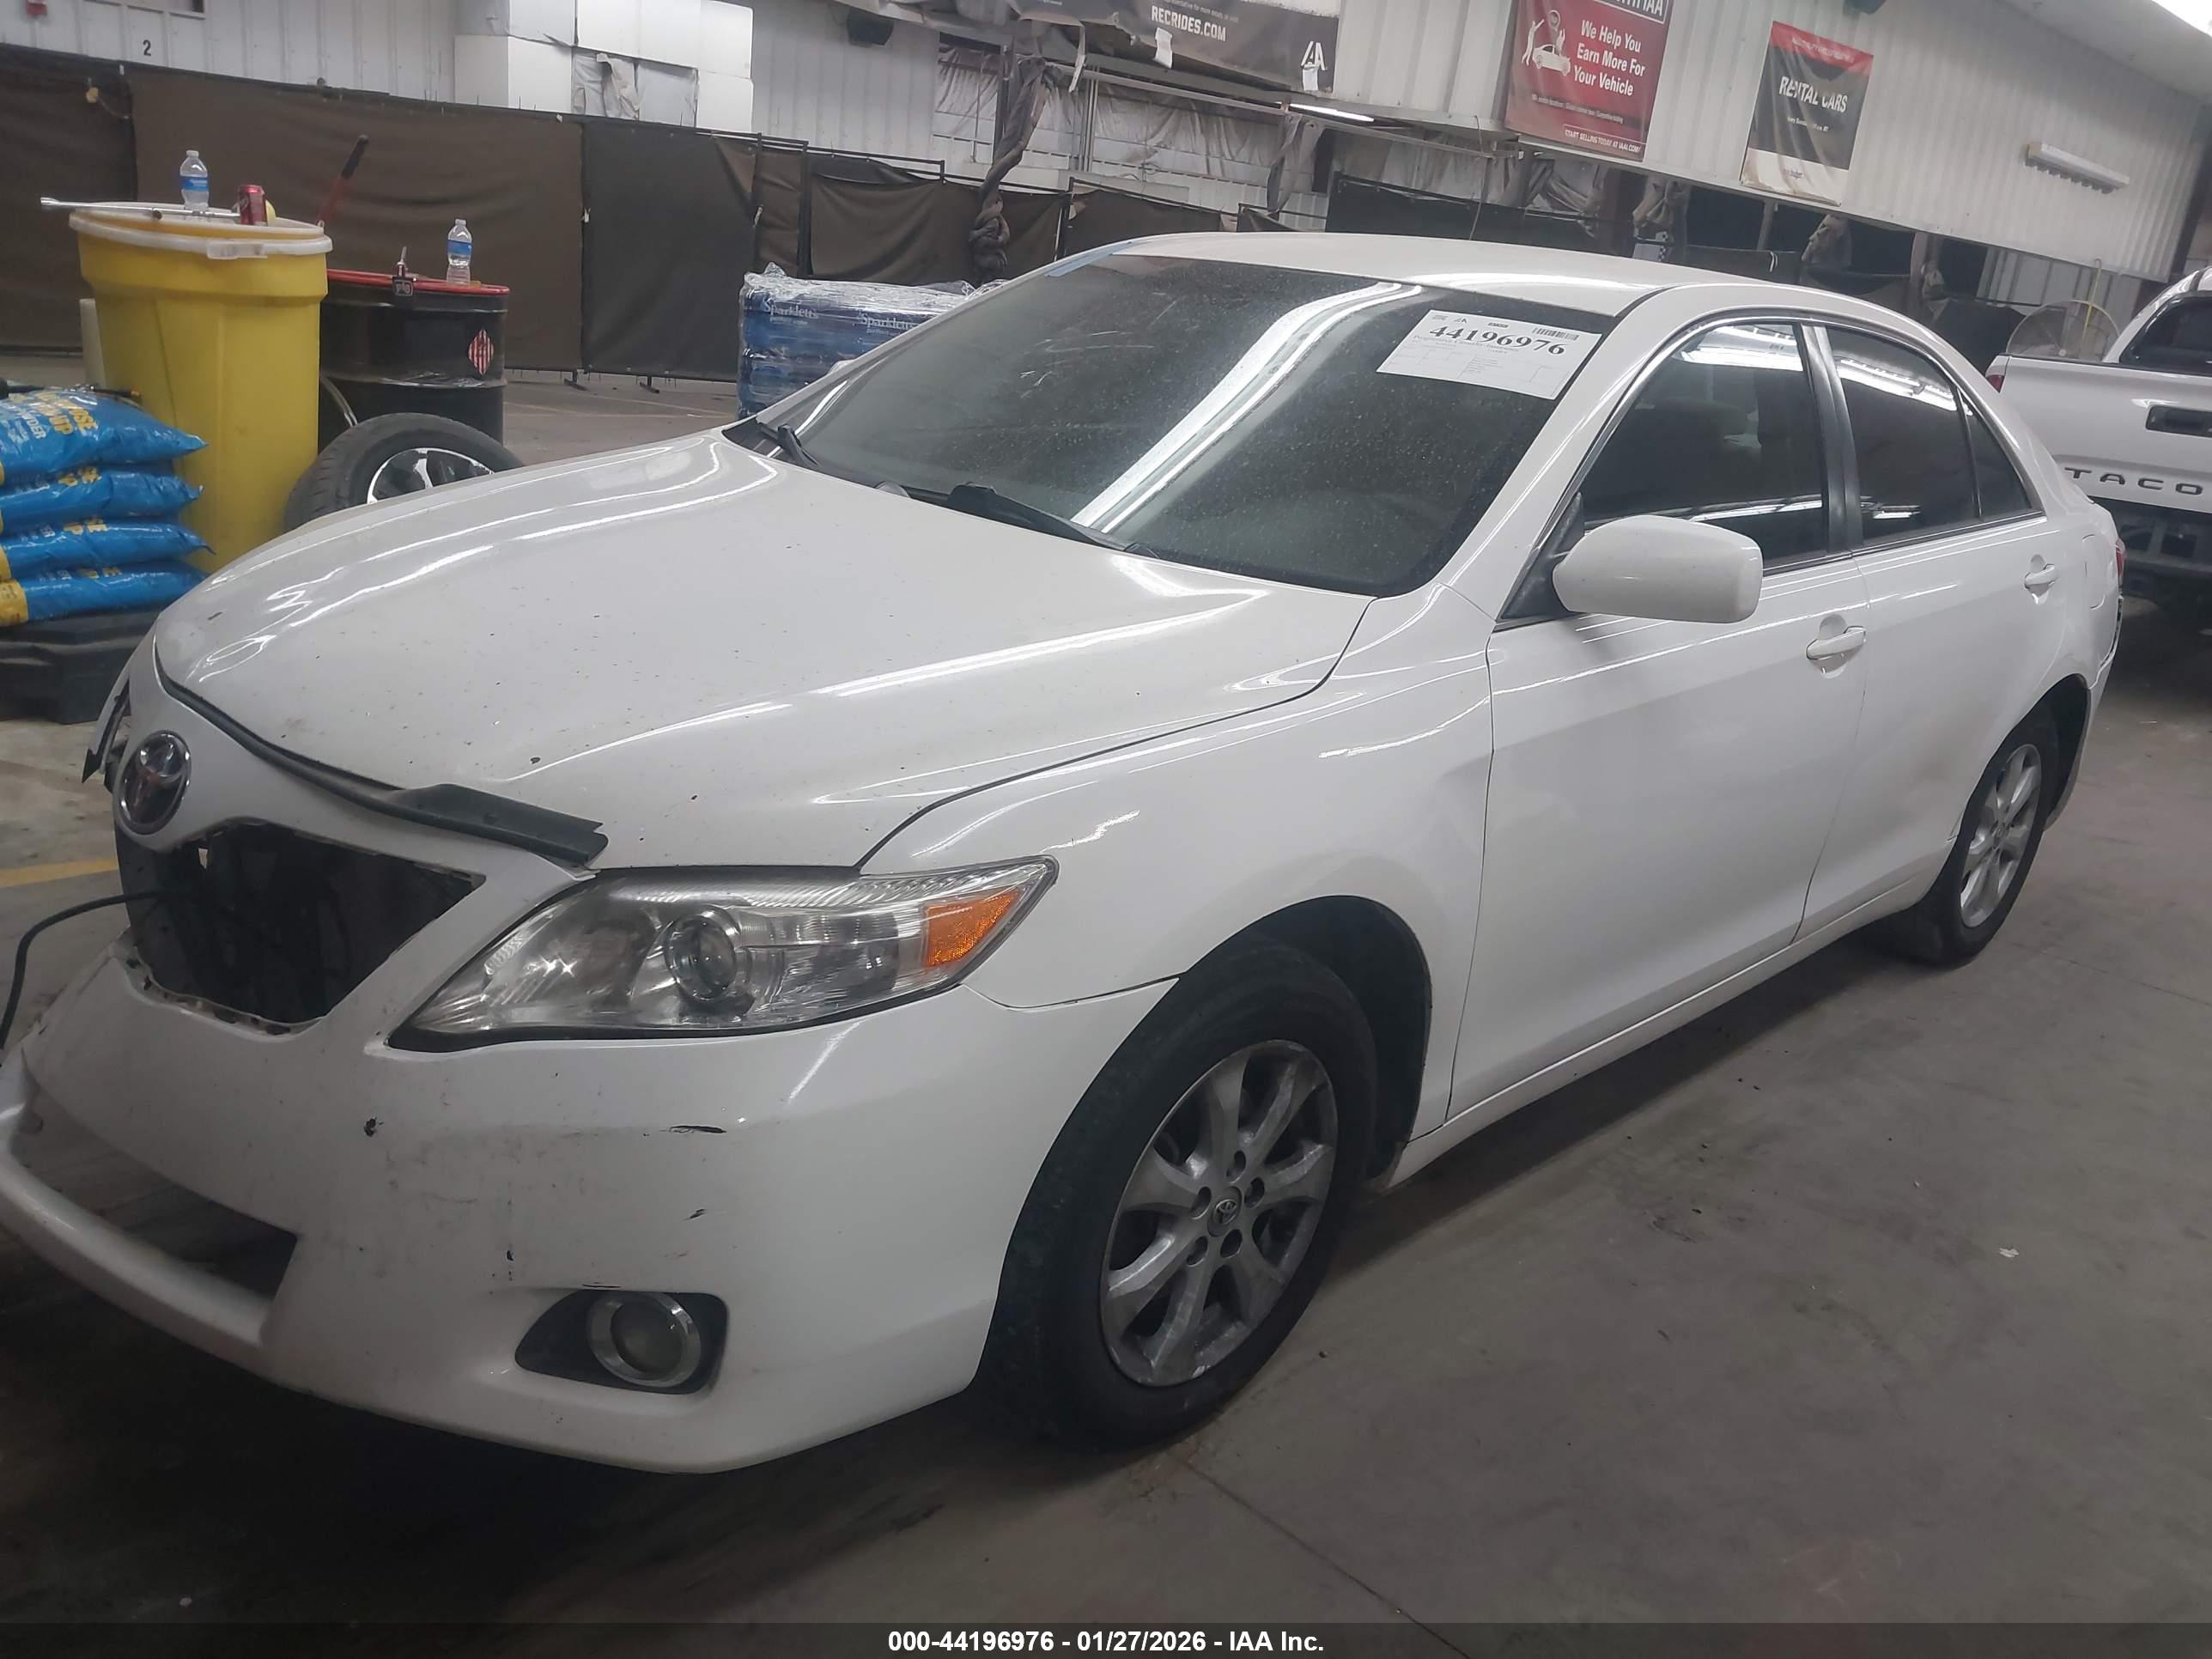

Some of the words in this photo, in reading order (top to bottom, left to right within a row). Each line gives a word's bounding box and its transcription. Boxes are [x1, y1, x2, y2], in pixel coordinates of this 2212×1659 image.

[1152, 5, 1226, 41] RECRIDES.COM
[1581, 20, 1597, 40] We
[1599, 25, 1621, 49] Help
[1625, 33, 1642, 53] You
[143, 40, 151, 57] 2
[1577, 42, 1600, 64] Earn
[1601, 50, 1628, 71] More
[1629, 58, 1645, 76] For
[1573, 64, 1597, 87] Your
[1599, 71, 1634, 96] Vehicle
[1778, 76, 1819, 106] RENTAL
[1565, 129, 1579, 138] START
[1598, 137, 1613, 146] TODAY
[1430, 325, 1565, 356] 44196976
[2064, 467, 2203, 496] TACO
